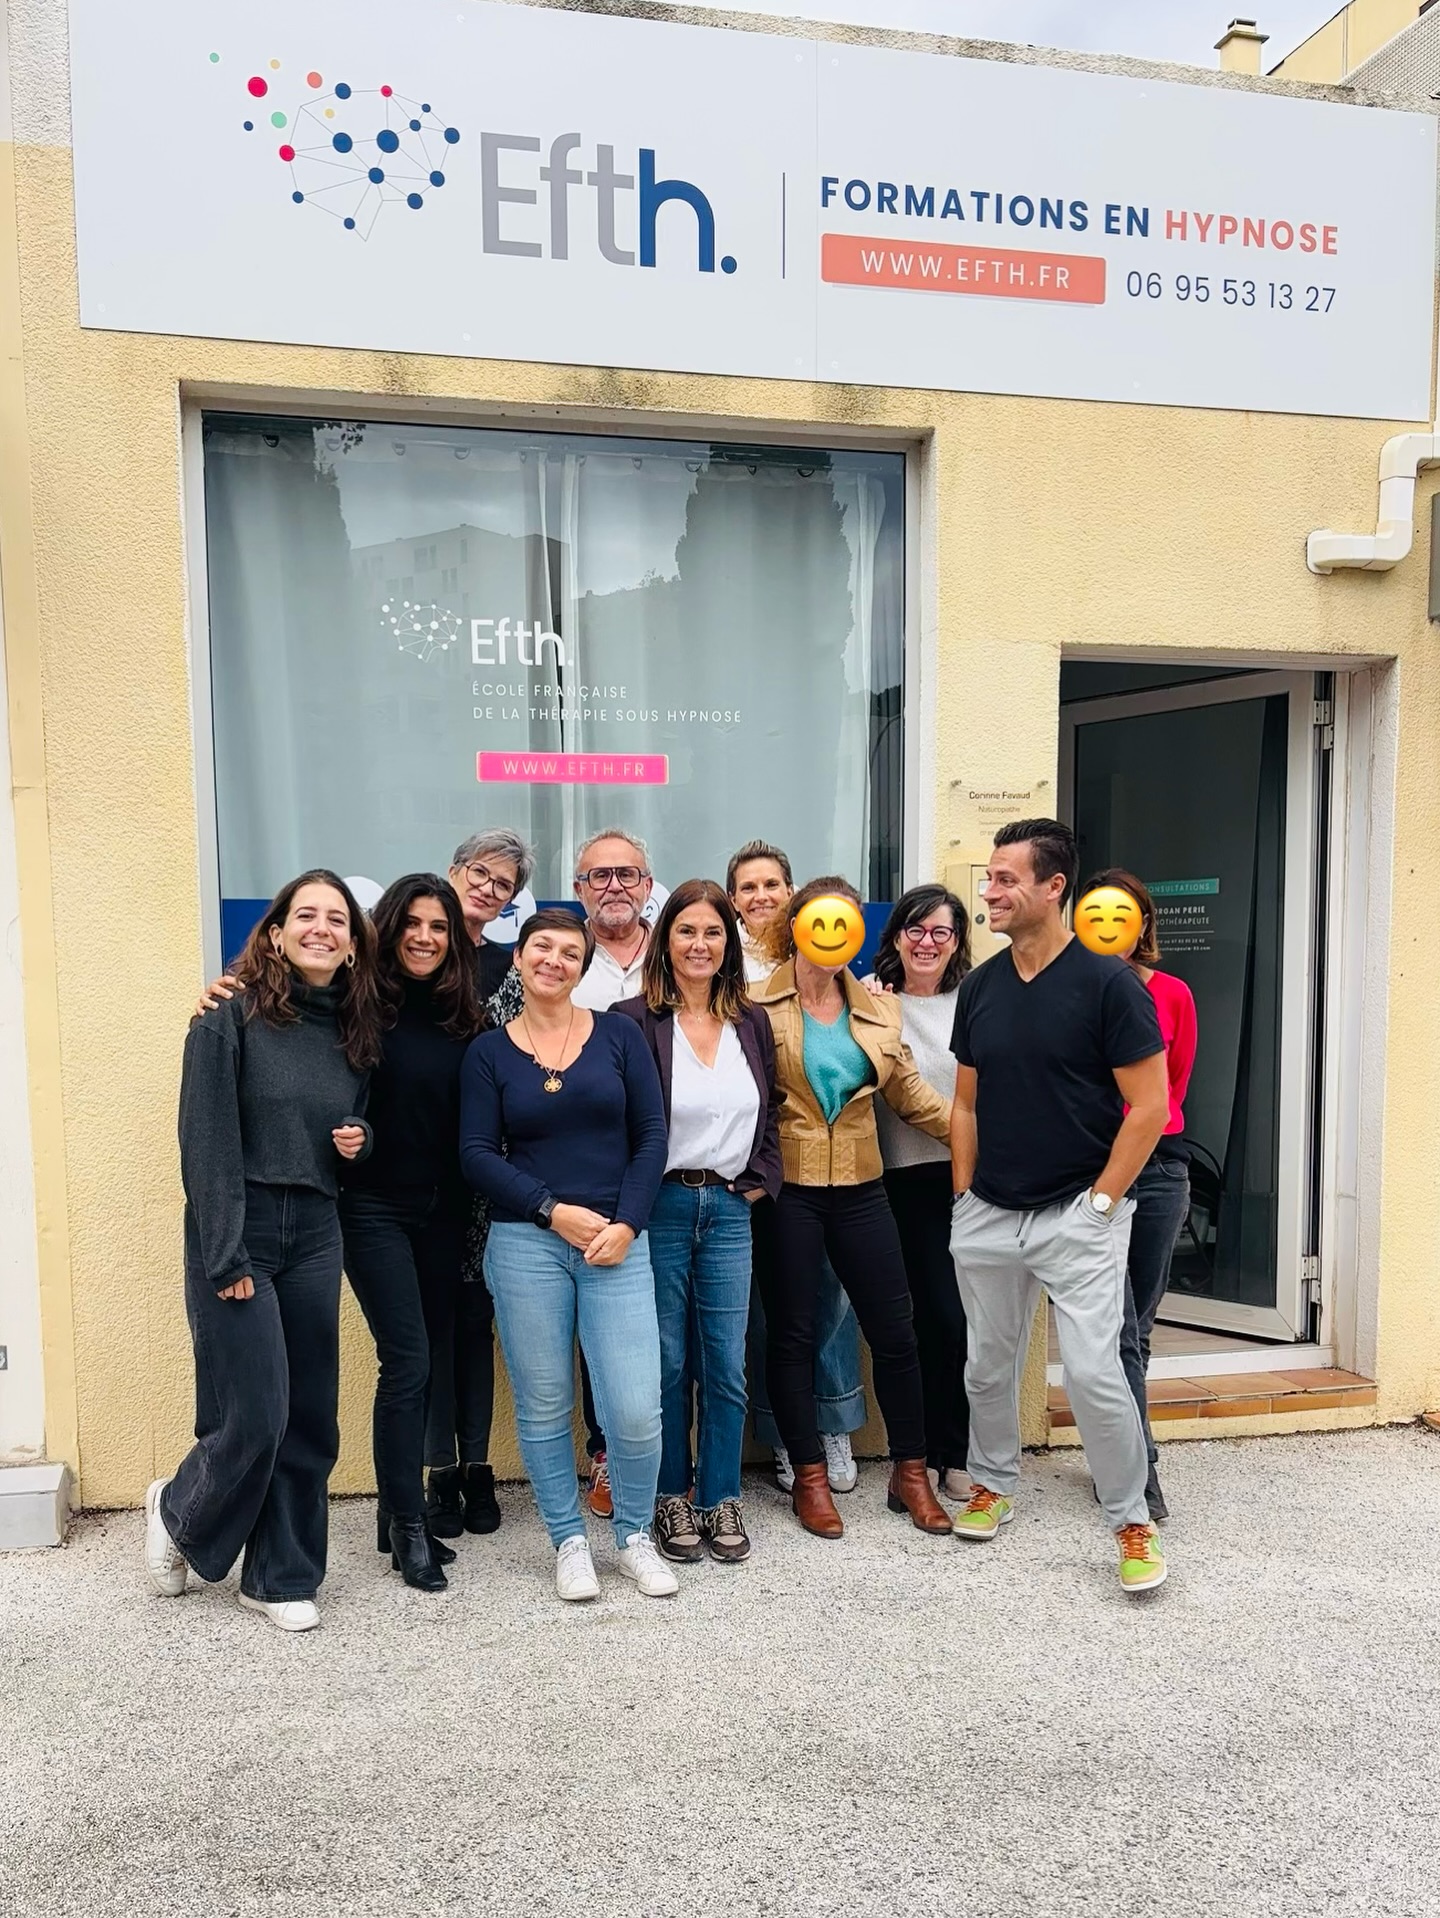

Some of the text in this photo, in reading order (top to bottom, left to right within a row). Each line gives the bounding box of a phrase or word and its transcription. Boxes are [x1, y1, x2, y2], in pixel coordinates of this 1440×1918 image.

[480, 131, 738, 275] Efth.
[820, 175, 1340, 256] FORMATIONS EN HYPNOSE
[860, 249, 1071, 290] WWW.EFTH.FR
[1126, 270, 1337, 314] 06 95 53 13 27
[470, 617, 575, 667] Efth.
[472, 680, 628, 700] ÉCOLE FRANÇAISE
[473, 705, 742, 724] DE LA THÉRAPIE SOUS HYPNOSE
[503, 760, 645, 778] WWW.EFTH.FR
[969, 791, 1031, 799] Corinne Favaud
[1183, 905, 1205, 914] PERIE
[1155, 917, 1209, 925] NOTHÉRAPEUTE
